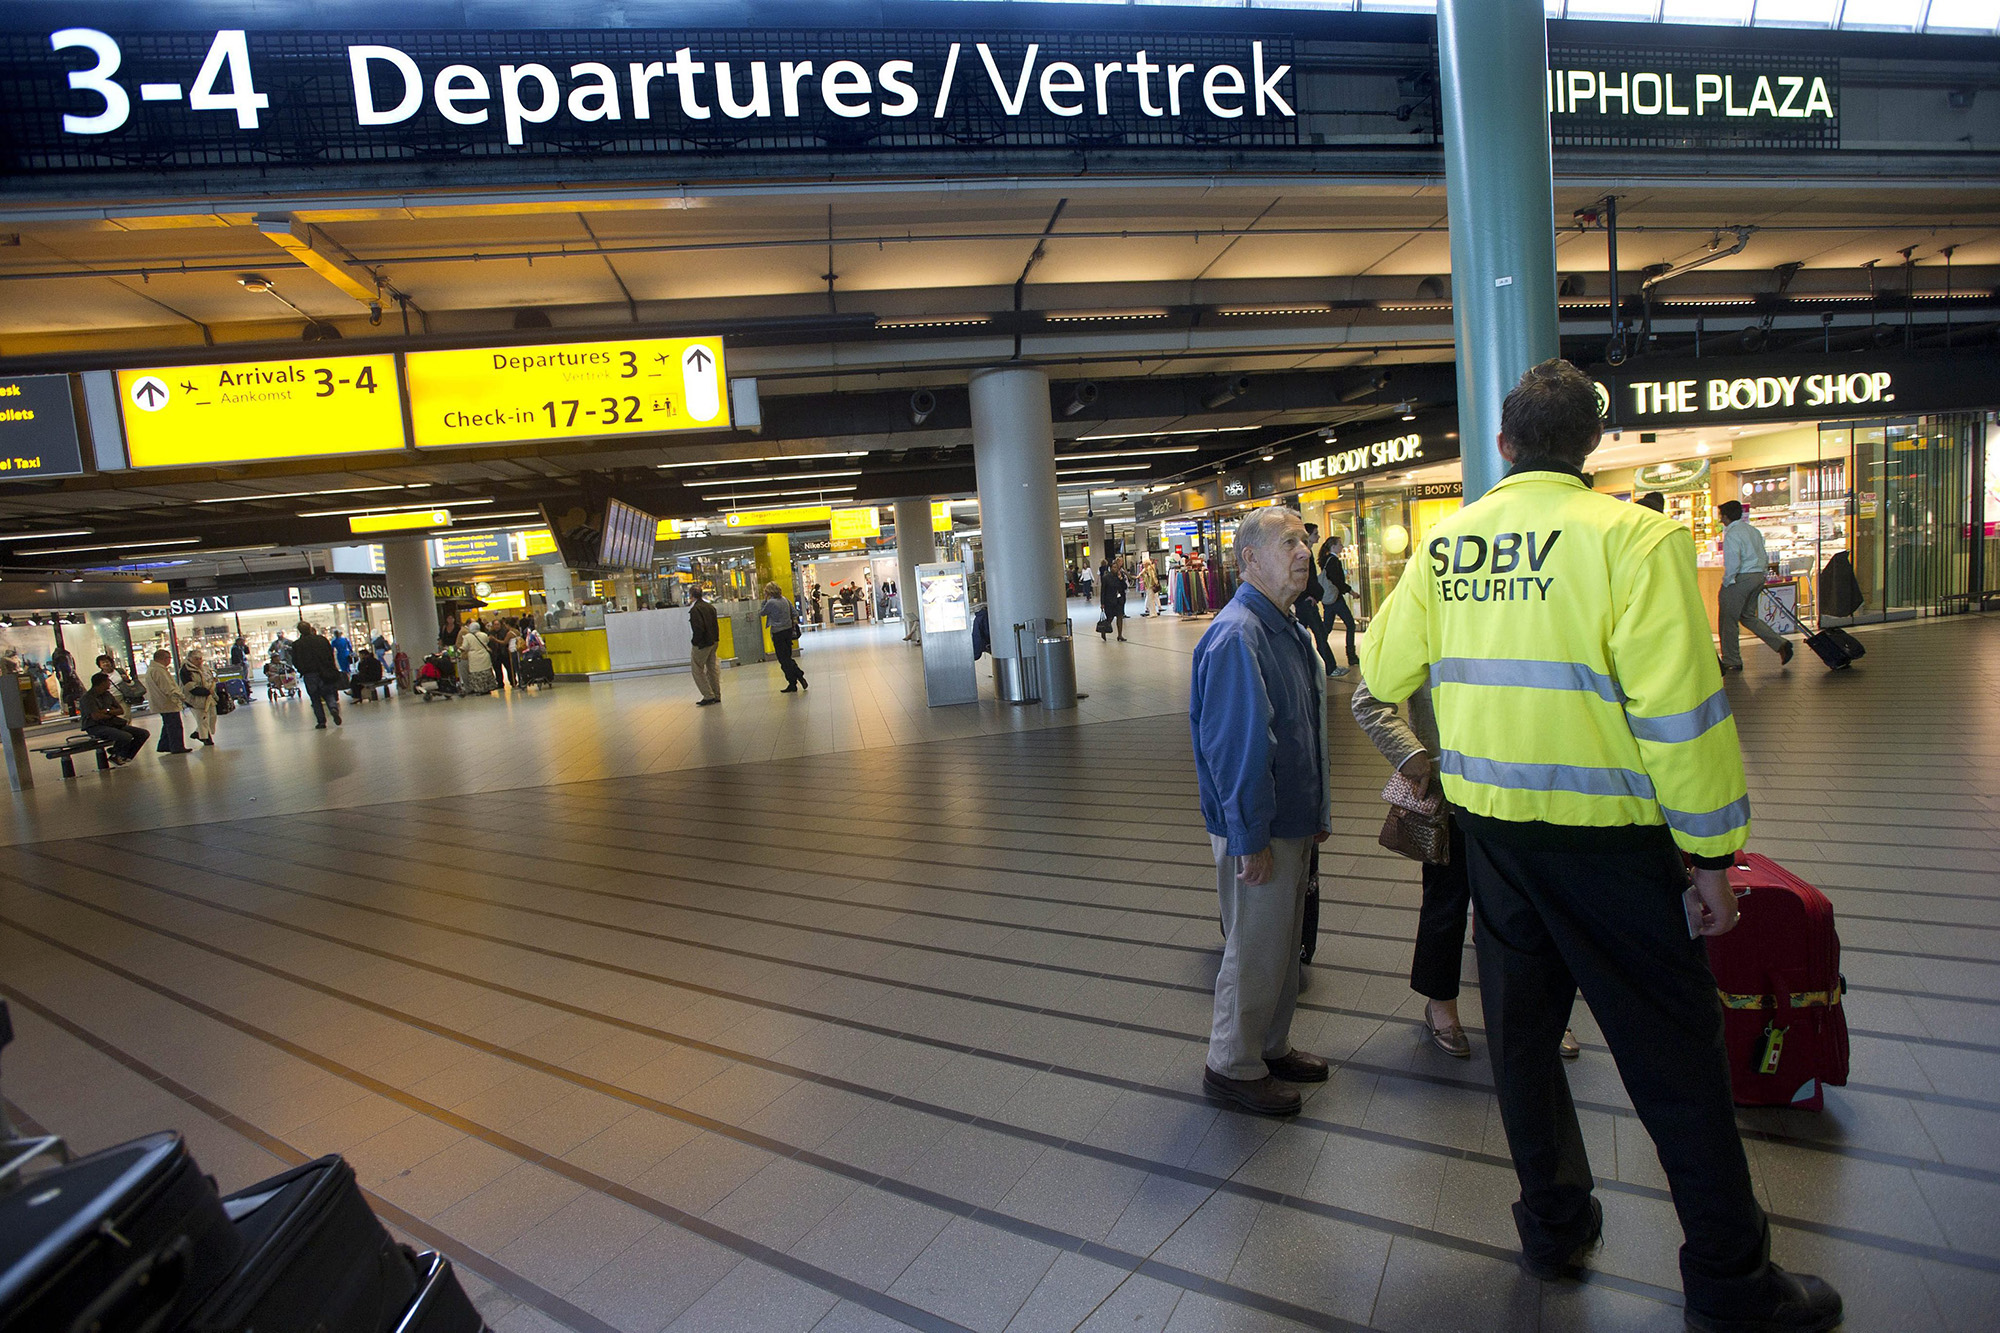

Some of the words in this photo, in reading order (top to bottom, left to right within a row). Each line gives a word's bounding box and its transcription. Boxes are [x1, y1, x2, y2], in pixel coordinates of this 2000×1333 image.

[50, 28, 269, 134] 3-4
[1548, 69, 1689, 116] IPHOL
[1696, 74, 1834, 118] PLAZA
[492, 349, 611, 373] Departures
[620, 350, 639, 379] 3
[562, 368, 612, 383] Vertrek
[0, 384, 21, 397] esk
[218, 365, 307, 388] Arrivals
[313, 365, 379, 398] 3-4
[1629, 380, 1699, 415] THE
[1707, 375, 1801, 411] BODY
[220, 389, 293, 406] Aankomst
[443, 408, 535, 429] Check-in
[541, 395, 643, 429] 17-32
[14, 456, 41, 469] Taxi
[1297, 457, 1326, 482] THE
[1327, 445, 1371, 477] BODY
[1404, 486, 1422, 496] THE
[1424, 484, 1451, 495] BODY
[1453, 483, 1463, 494] SH
[1429, 530, 1563, 578] SDBV
[359, 584, 389, 599] GASSA
[433, 586, 450, 597] RAND
[1437, 577, 1555, 602] SECURITY
